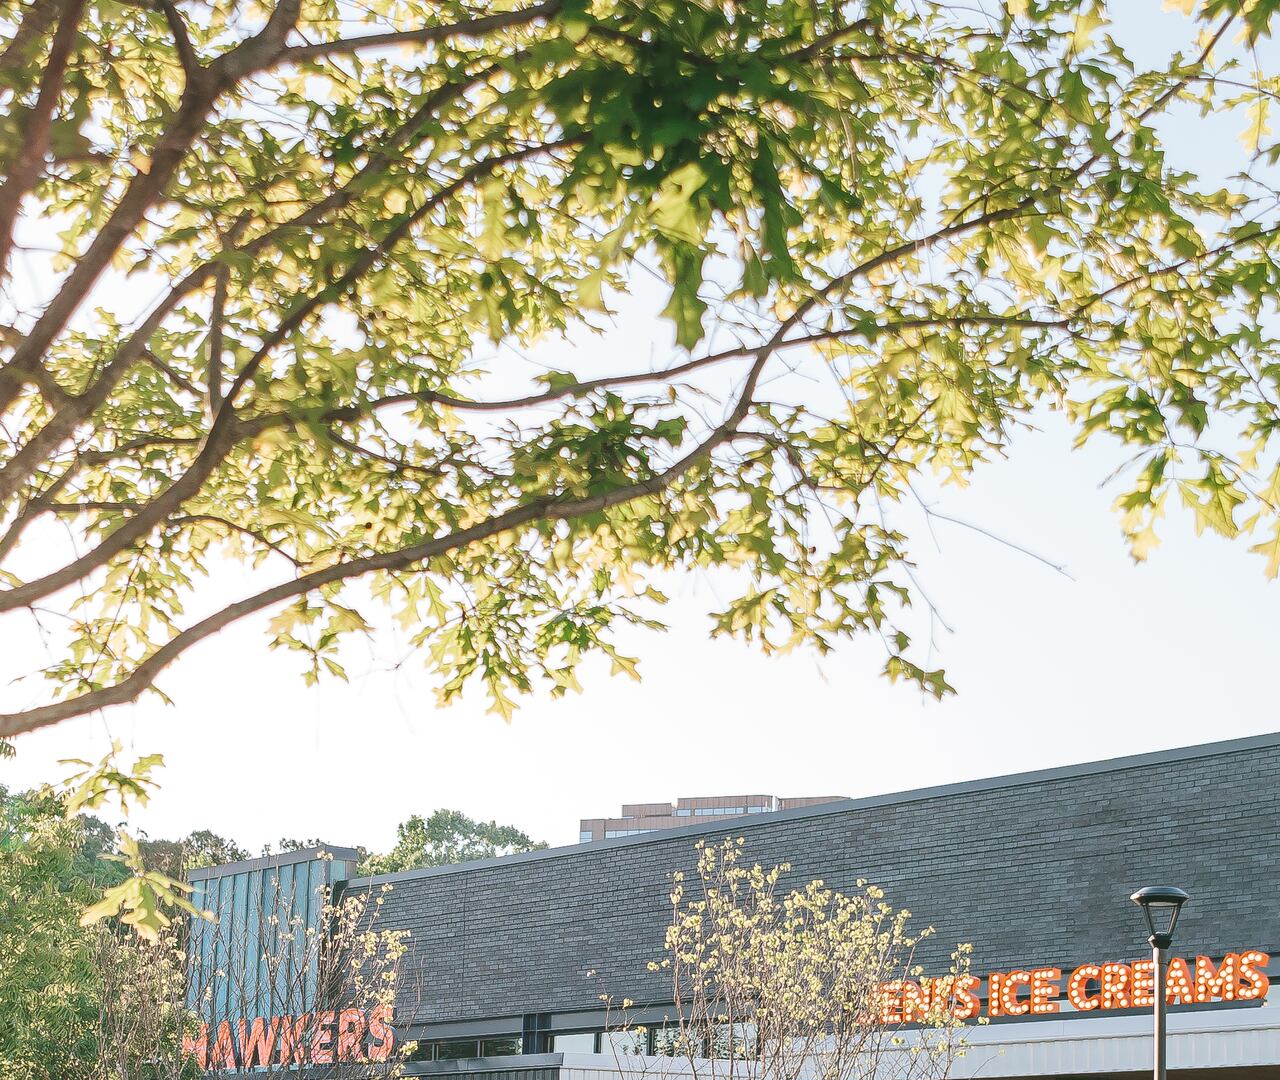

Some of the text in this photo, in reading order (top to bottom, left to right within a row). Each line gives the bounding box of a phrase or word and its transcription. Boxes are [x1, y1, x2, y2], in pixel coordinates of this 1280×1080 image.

[988, 967, 1062, 1017] ICE
[1067, 950, 1270, 1011] CREAMS
[183, 1003, 398, 1071] HAWKERS
